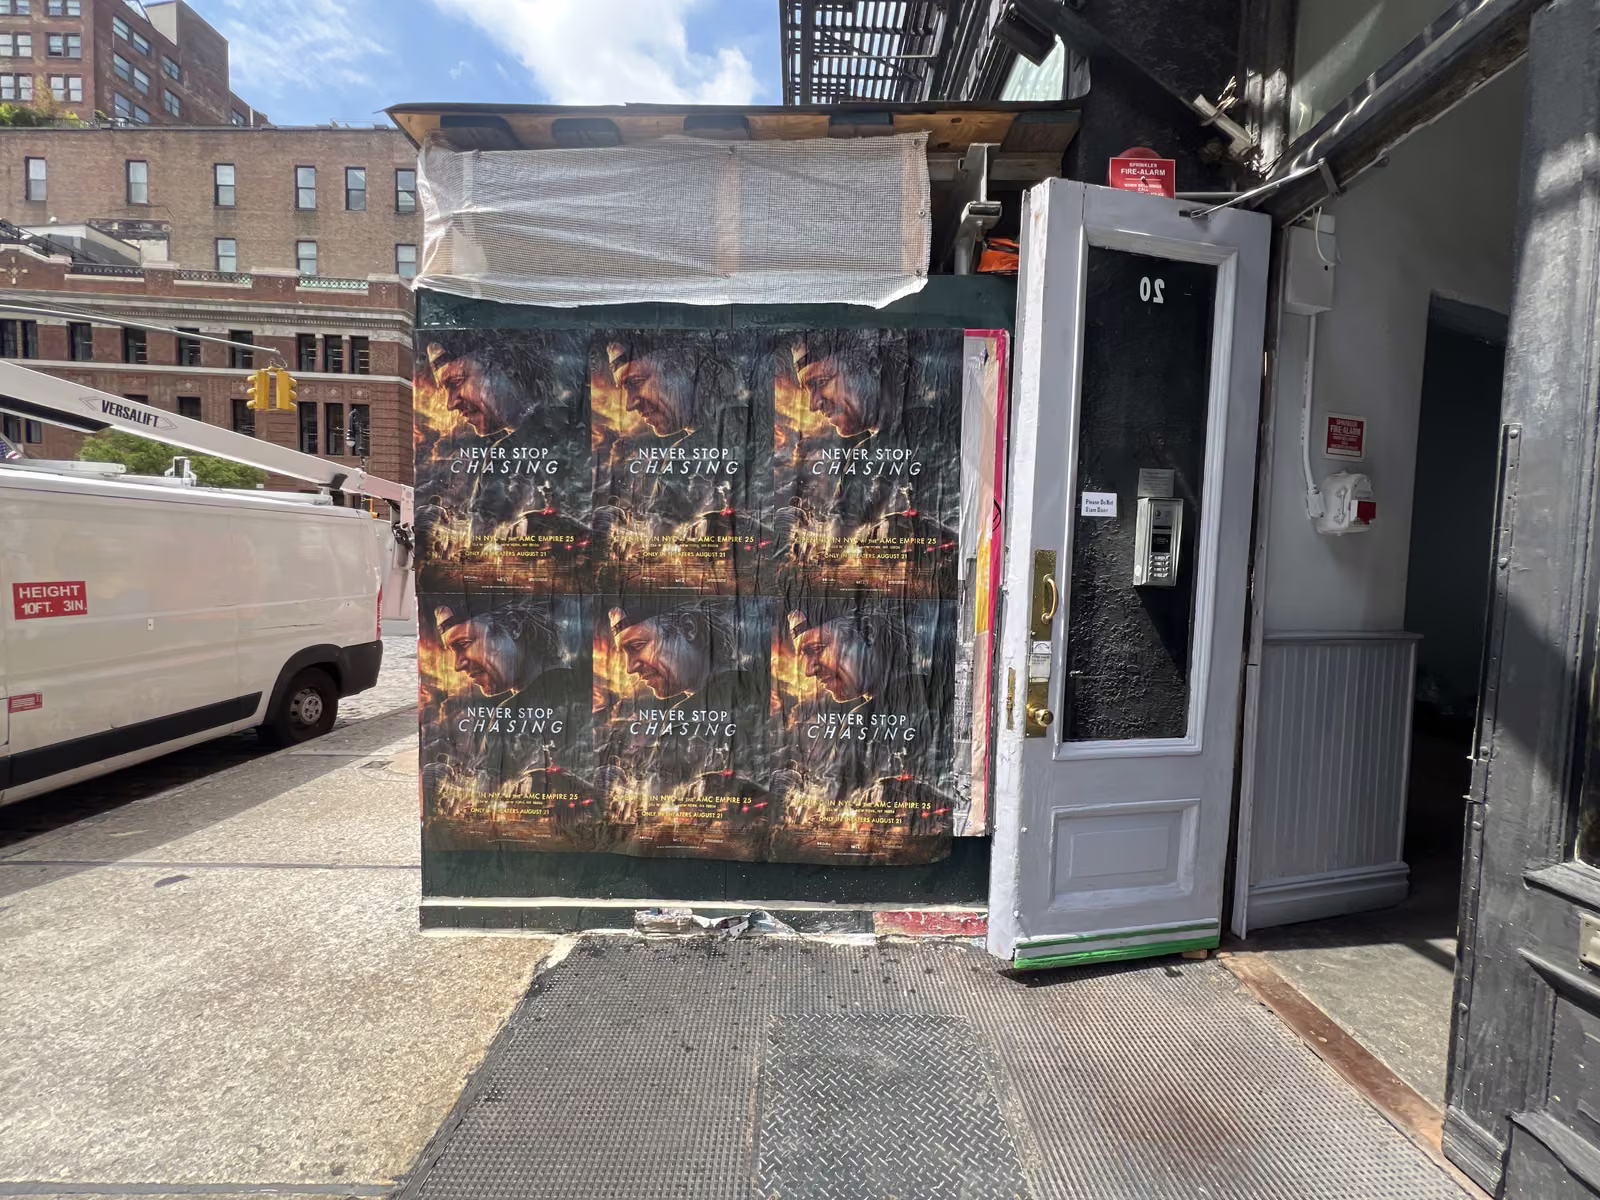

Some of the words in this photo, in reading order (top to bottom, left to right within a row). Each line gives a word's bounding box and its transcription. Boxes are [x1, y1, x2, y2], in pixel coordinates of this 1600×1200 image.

[1120, 168, 1166, 176] FIRE-ALARM
[101, 399, 160, 428] VERSALIFT
[459, 447, 506, 459] NEVER
[512, 447, 550, 459] STOP
[639, 447, 686, 460] NEVER
[692, 447, 729, 460] STOP
[821, 448, 869, 460] NEVER
[875, 448, 912, 460] STOP
[450, 460, 559, 474] CHASING
[629, 461, 739, 475] CHASING
[812, 461, 922, 475] CHASING
[745, 536, 754, 544] 25
[927, 537, 937, 545] 25
[18, 585, 80, 599] HEIGHT
[21, 601, 53, 615] 10FT.
[63, 600, 88, 612] 3IN.
[467, 706, 512, 719] NEVER
[518, 707, 554, 719] STOP
[639, 709, 685, 721] NEVER
[692, 710, 728, 722] STOP
[458, 718, 563, 734] CHASING
[817, 713, 864, 726] NEVER
[870, 714, 906, 726] STOP
[629, 721, 737, 737] CHASING
[807, 725, 917, 742] CHASING
[569, 793, 578, 801] 25
[715, 796, 741, 804] EMPIRE
[893, 801, 919, 809] EMPIRE
